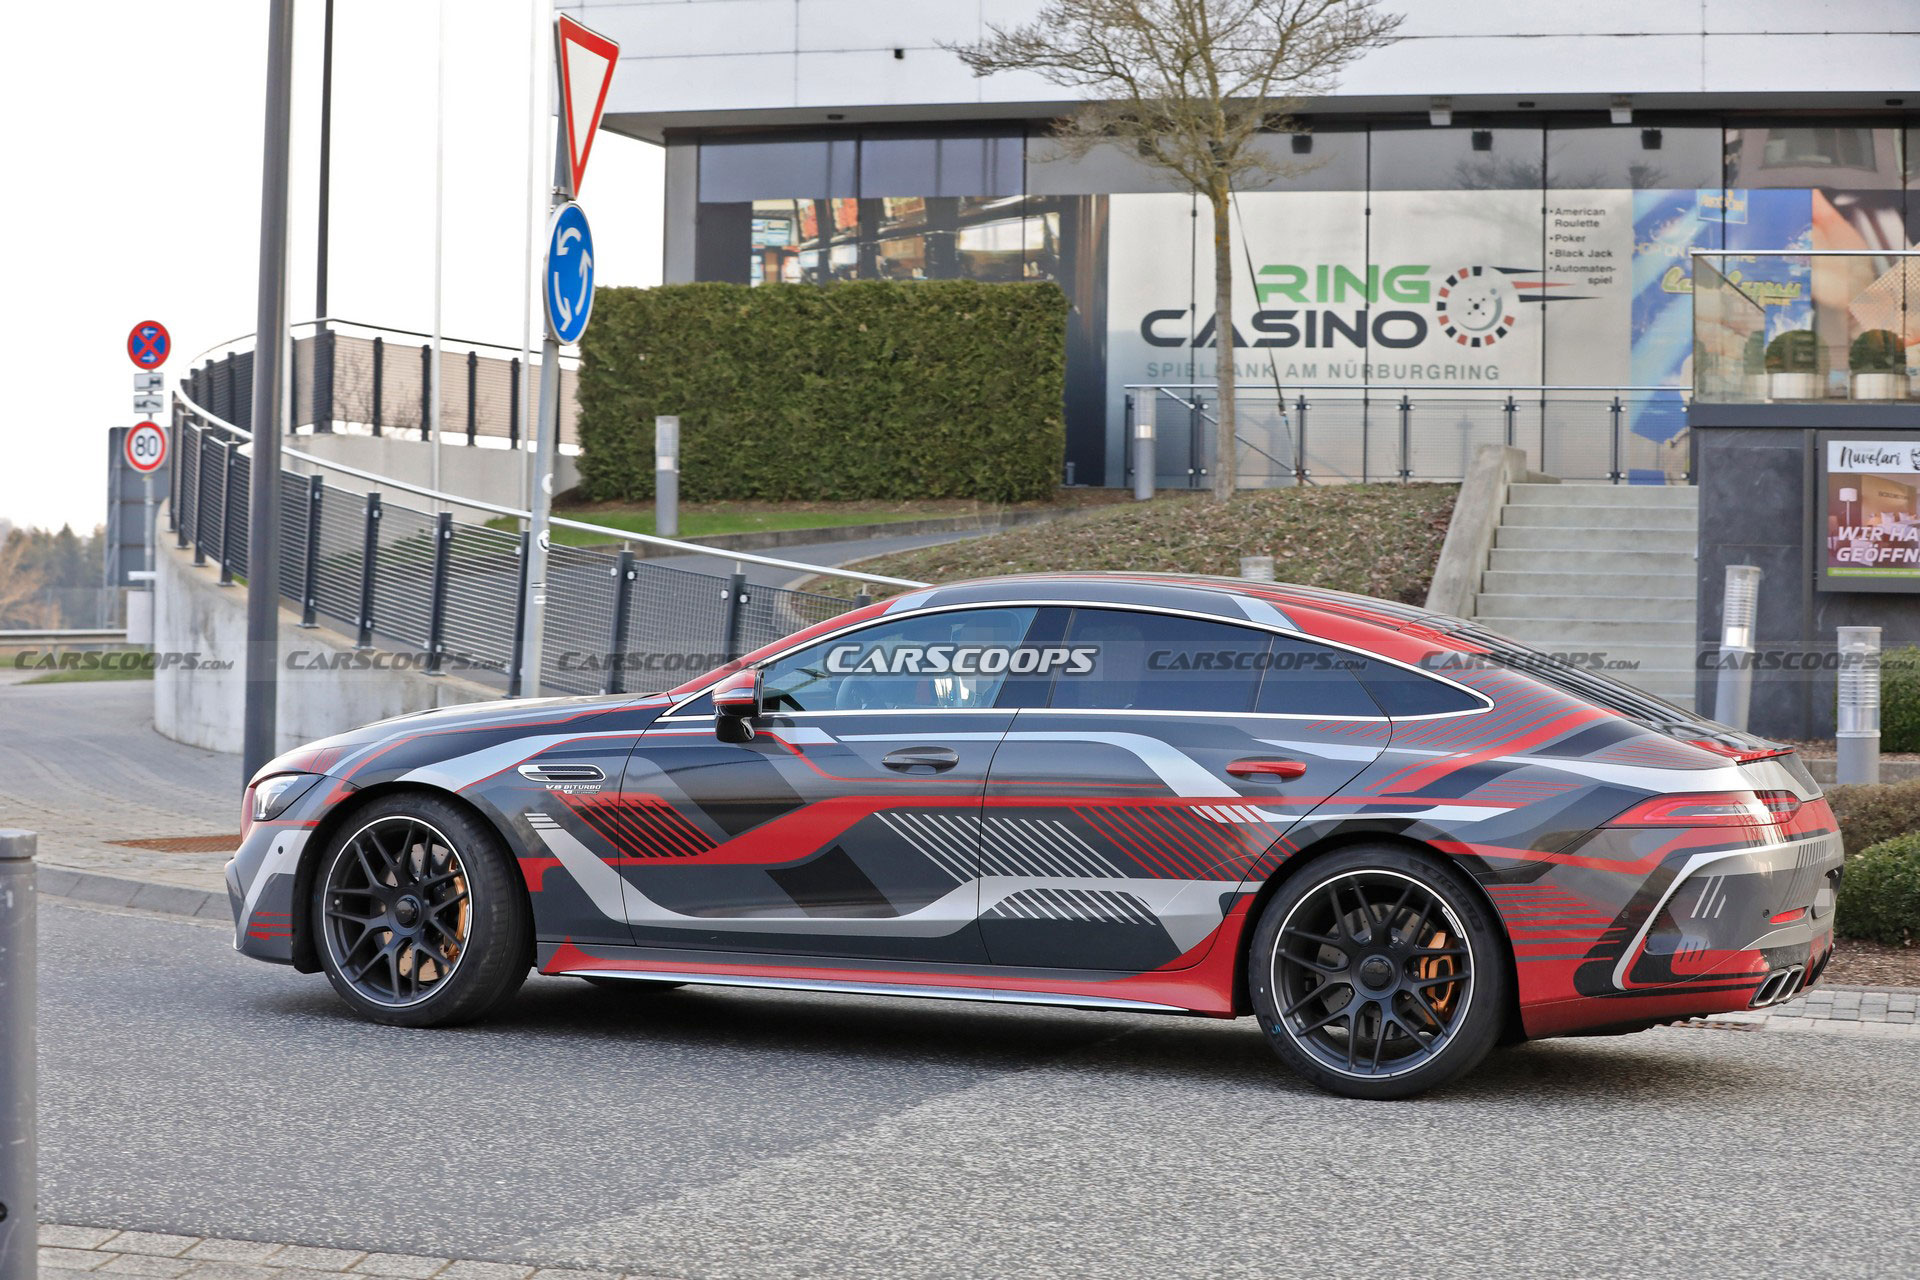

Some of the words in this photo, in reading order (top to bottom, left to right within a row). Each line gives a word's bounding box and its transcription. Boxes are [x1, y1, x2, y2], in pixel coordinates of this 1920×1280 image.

[1554, 207, 1606, 216] American
[1554, 219, 1600, 228] Roulette
[1554, 234, 1586, 243] Poker
[1554, 249, 1584, 258] Black
[1588, 249, 1613, 258] Jack
[1554, 264, 1616, 273] Automaten-
[1256, 264, 1432, 304] RING
[1588, 275, 1613, 286] spiel
[1140, 309, 1429, 349] CASINO
[1146, 361, 1275, 379] SPIELANK
[1286, 363, 1318, 379] AM
[1328, 360, 1500, 381] NÜRBURGRING
[135, 434, 158, 457] 80
[1838, 526, 1883, 541] WIR
[1836, 543, 1920, 562] GEÖFFN
